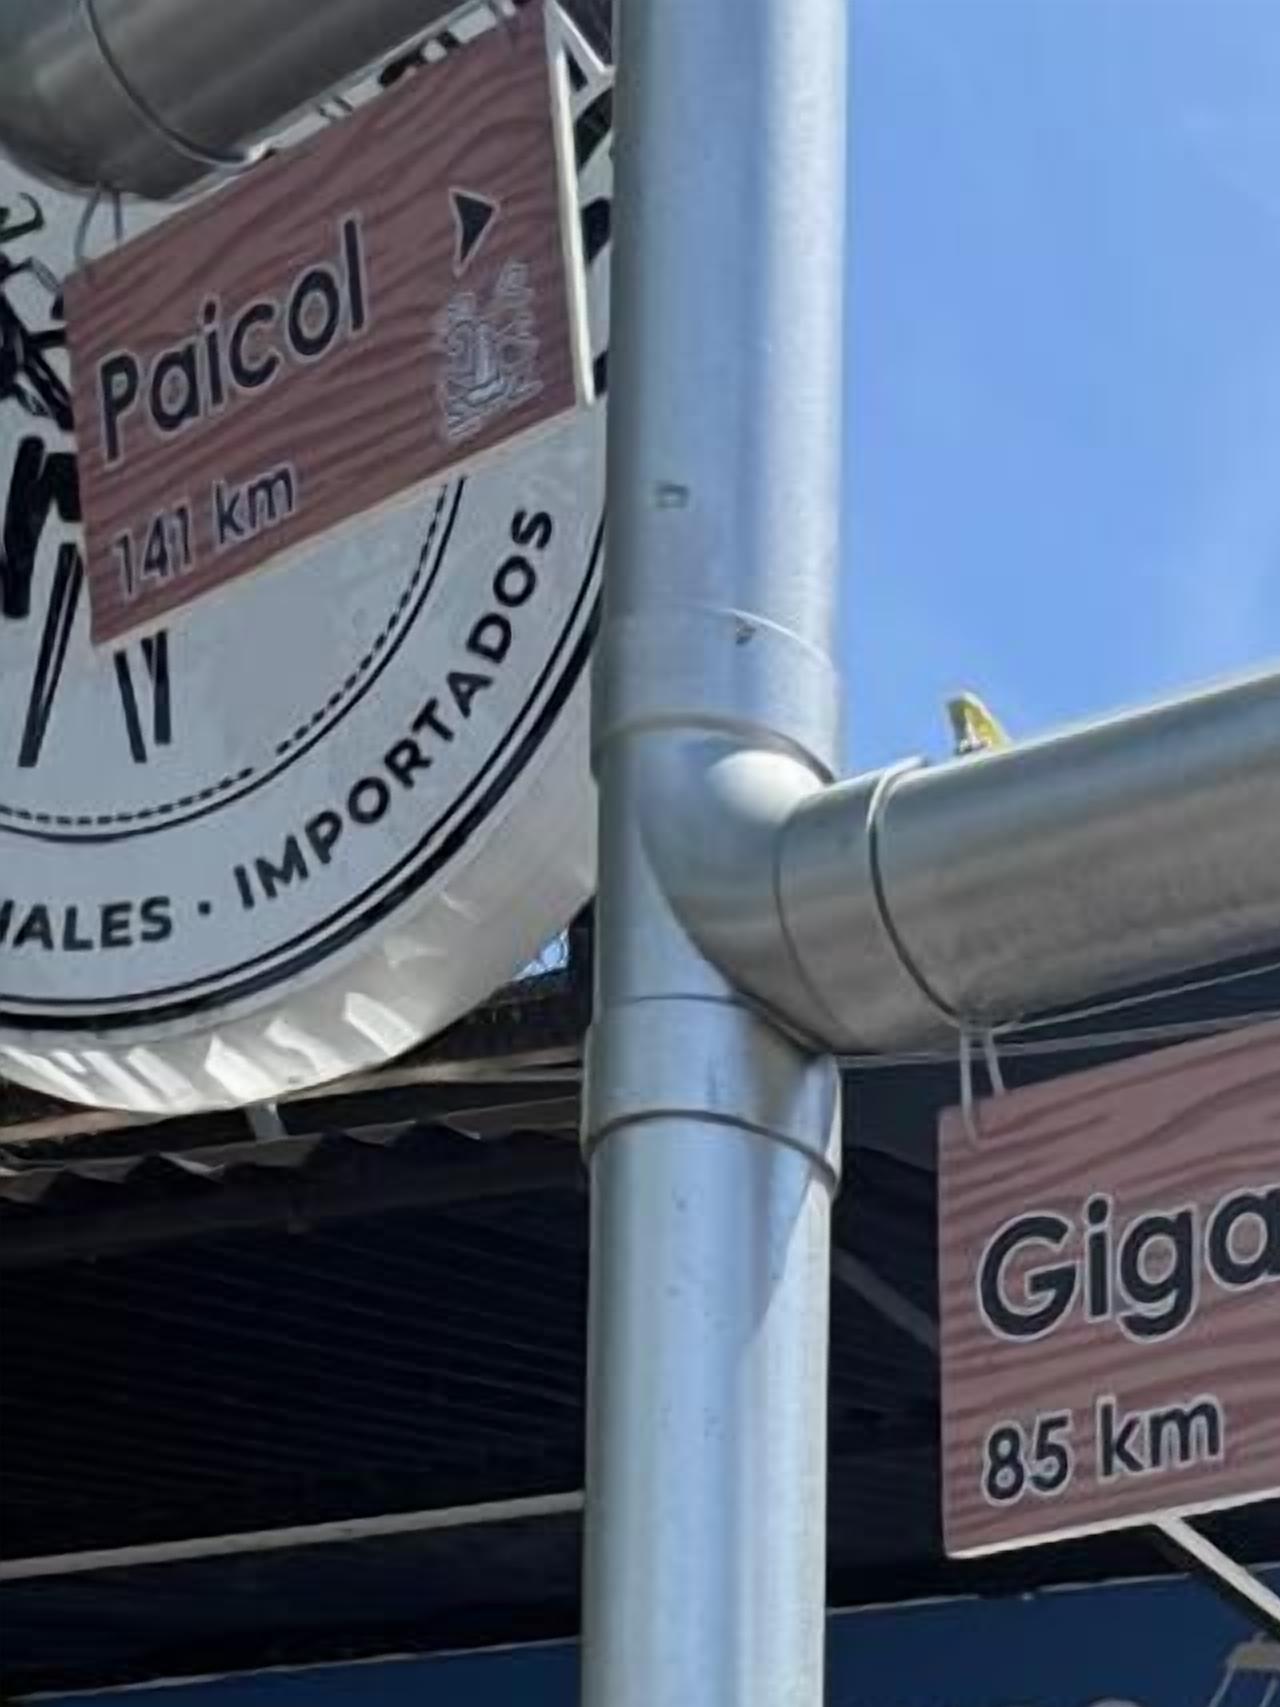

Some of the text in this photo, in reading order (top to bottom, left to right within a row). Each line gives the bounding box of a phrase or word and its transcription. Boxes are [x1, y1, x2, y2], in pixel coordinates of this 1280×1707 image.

[98, 217, 368, 463] Paicol
[113, 465, 297, 600] 141 km
[233, 507, 553, 910] IMPORTADOS
[982, 1395, 1223, 1505] 85 km
